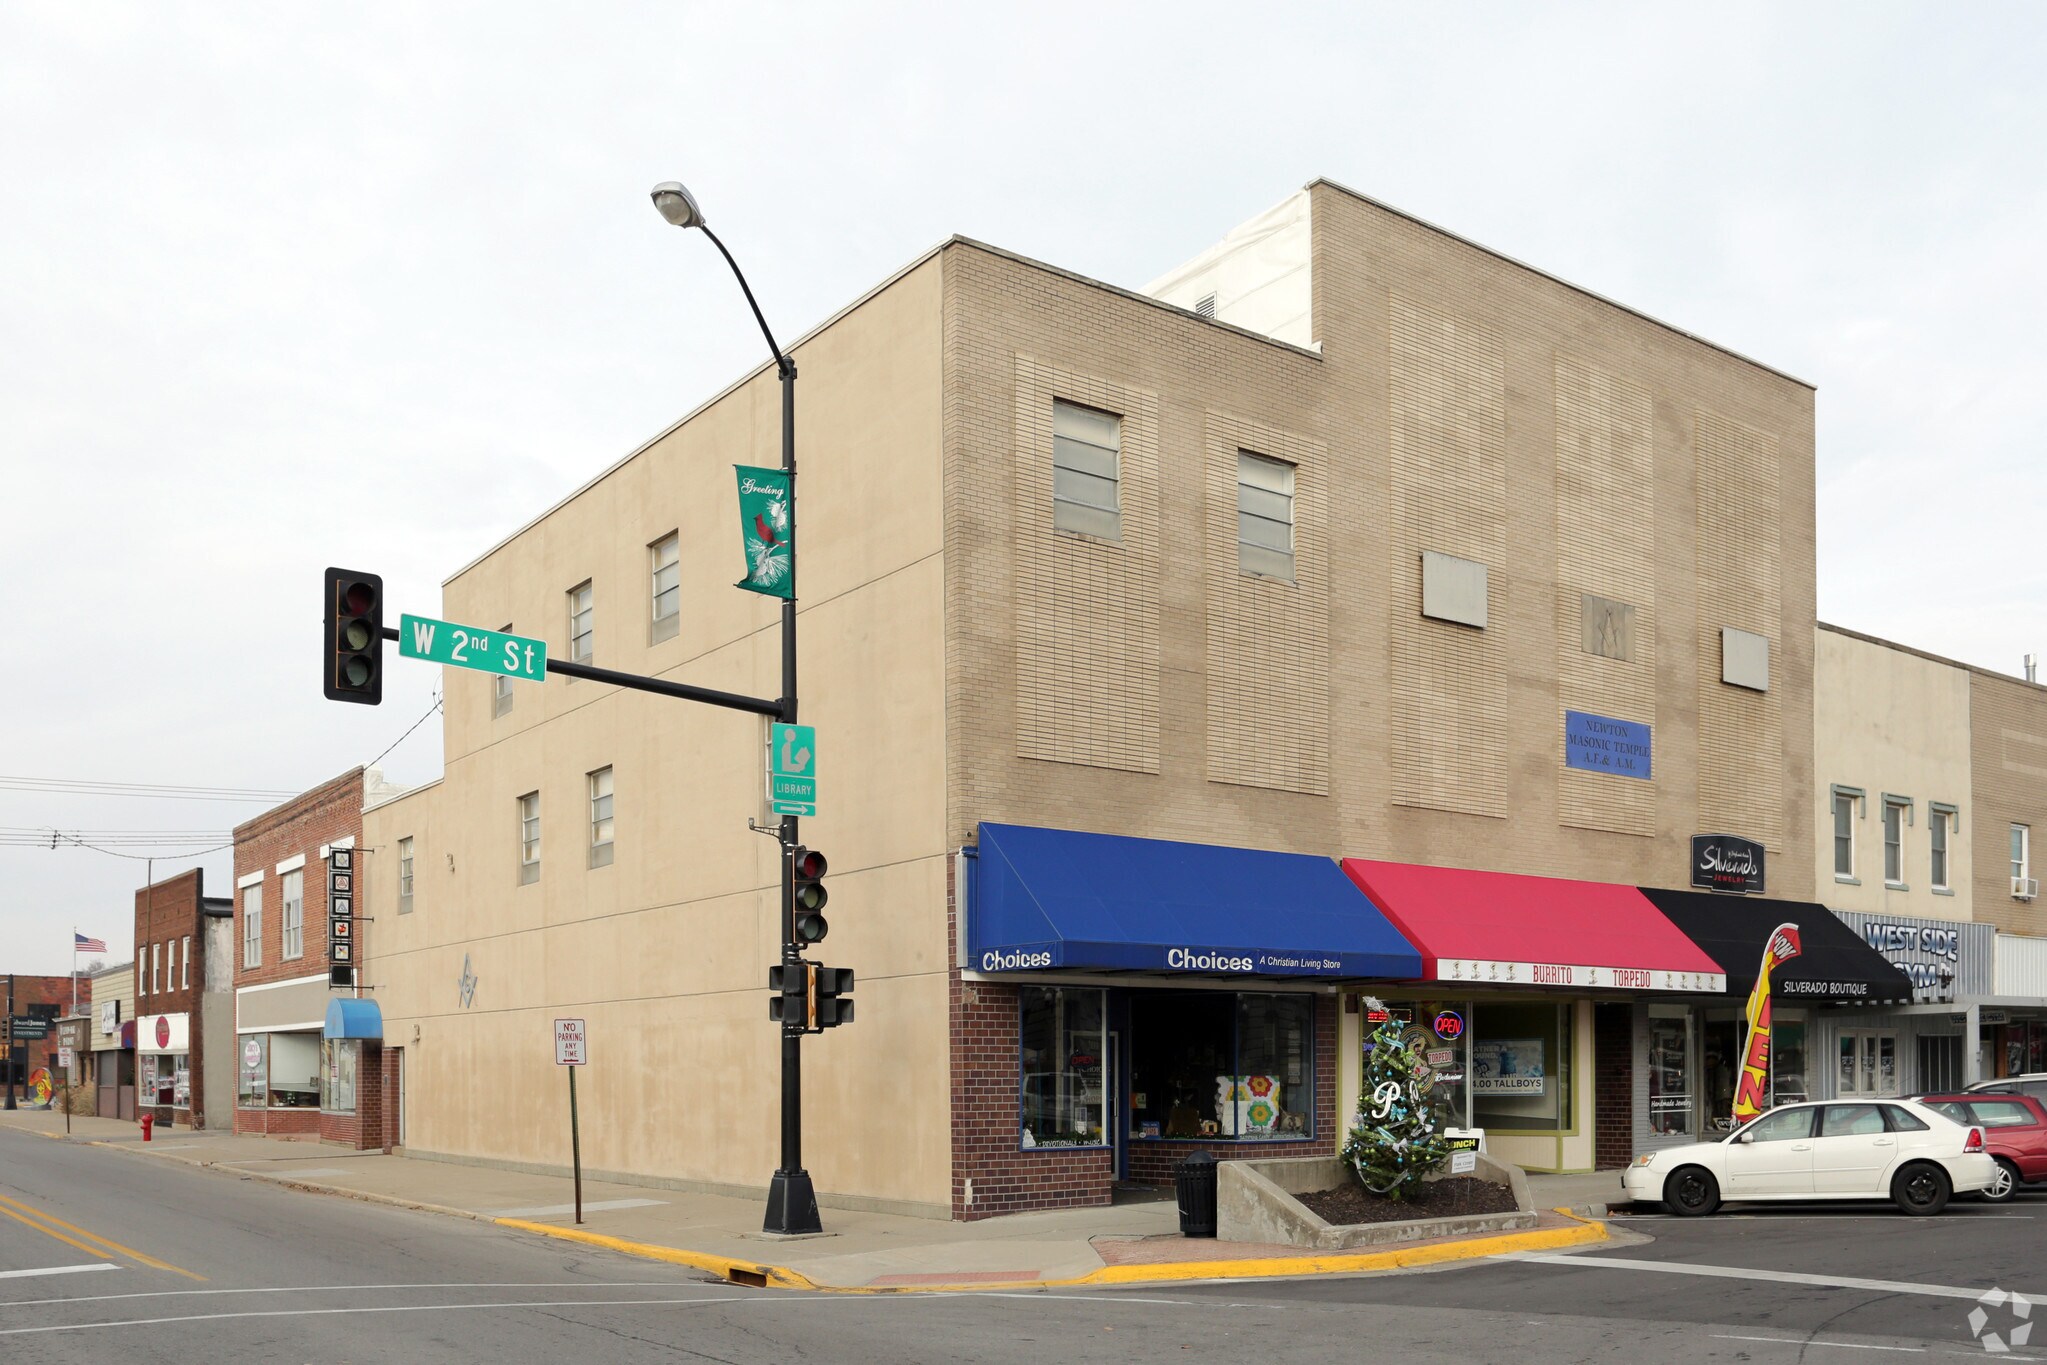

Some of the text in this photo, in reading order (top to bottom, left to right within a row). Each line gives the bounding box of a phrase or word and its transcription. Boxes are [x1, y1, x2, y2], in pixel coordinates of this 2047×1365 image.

[741, 477, 785, 500] Greeting
[413, 621, 535, 674] W 2nd St
[1586, 720, 1628, 738] NEWTON
[1569, 733, 1650, 758] MASONIC TEMPLE
[1615, 757, 1636, 770] A.M.
[776, 783, 812, 796] LIBRARY
[1713, 874, 1745, 884] JEWELRY
[1865, 922, 1958, 962] WEST SIDE
[982, 949, 1051, 971] Choices
[1167, 948, 1341, 971] Choices A Christian Living Store
[1533, 964, 1651, 988] BURRITO TORPEDO
[1783, 980, 1868, 996] SILVERADO BOUTIQUE
[563, 1023, 576, 1031] NO
[1436, 1018, 1461, 1033] OPEN
[558, 1033, 583, 1041] PARKING
[1427, 1050, 1453, 1065] TORPEDO
[1494, 1079, 1542, 1088] TALLBOYS
[1650, 1098, 1692, 1108] Handmade Jewelry
